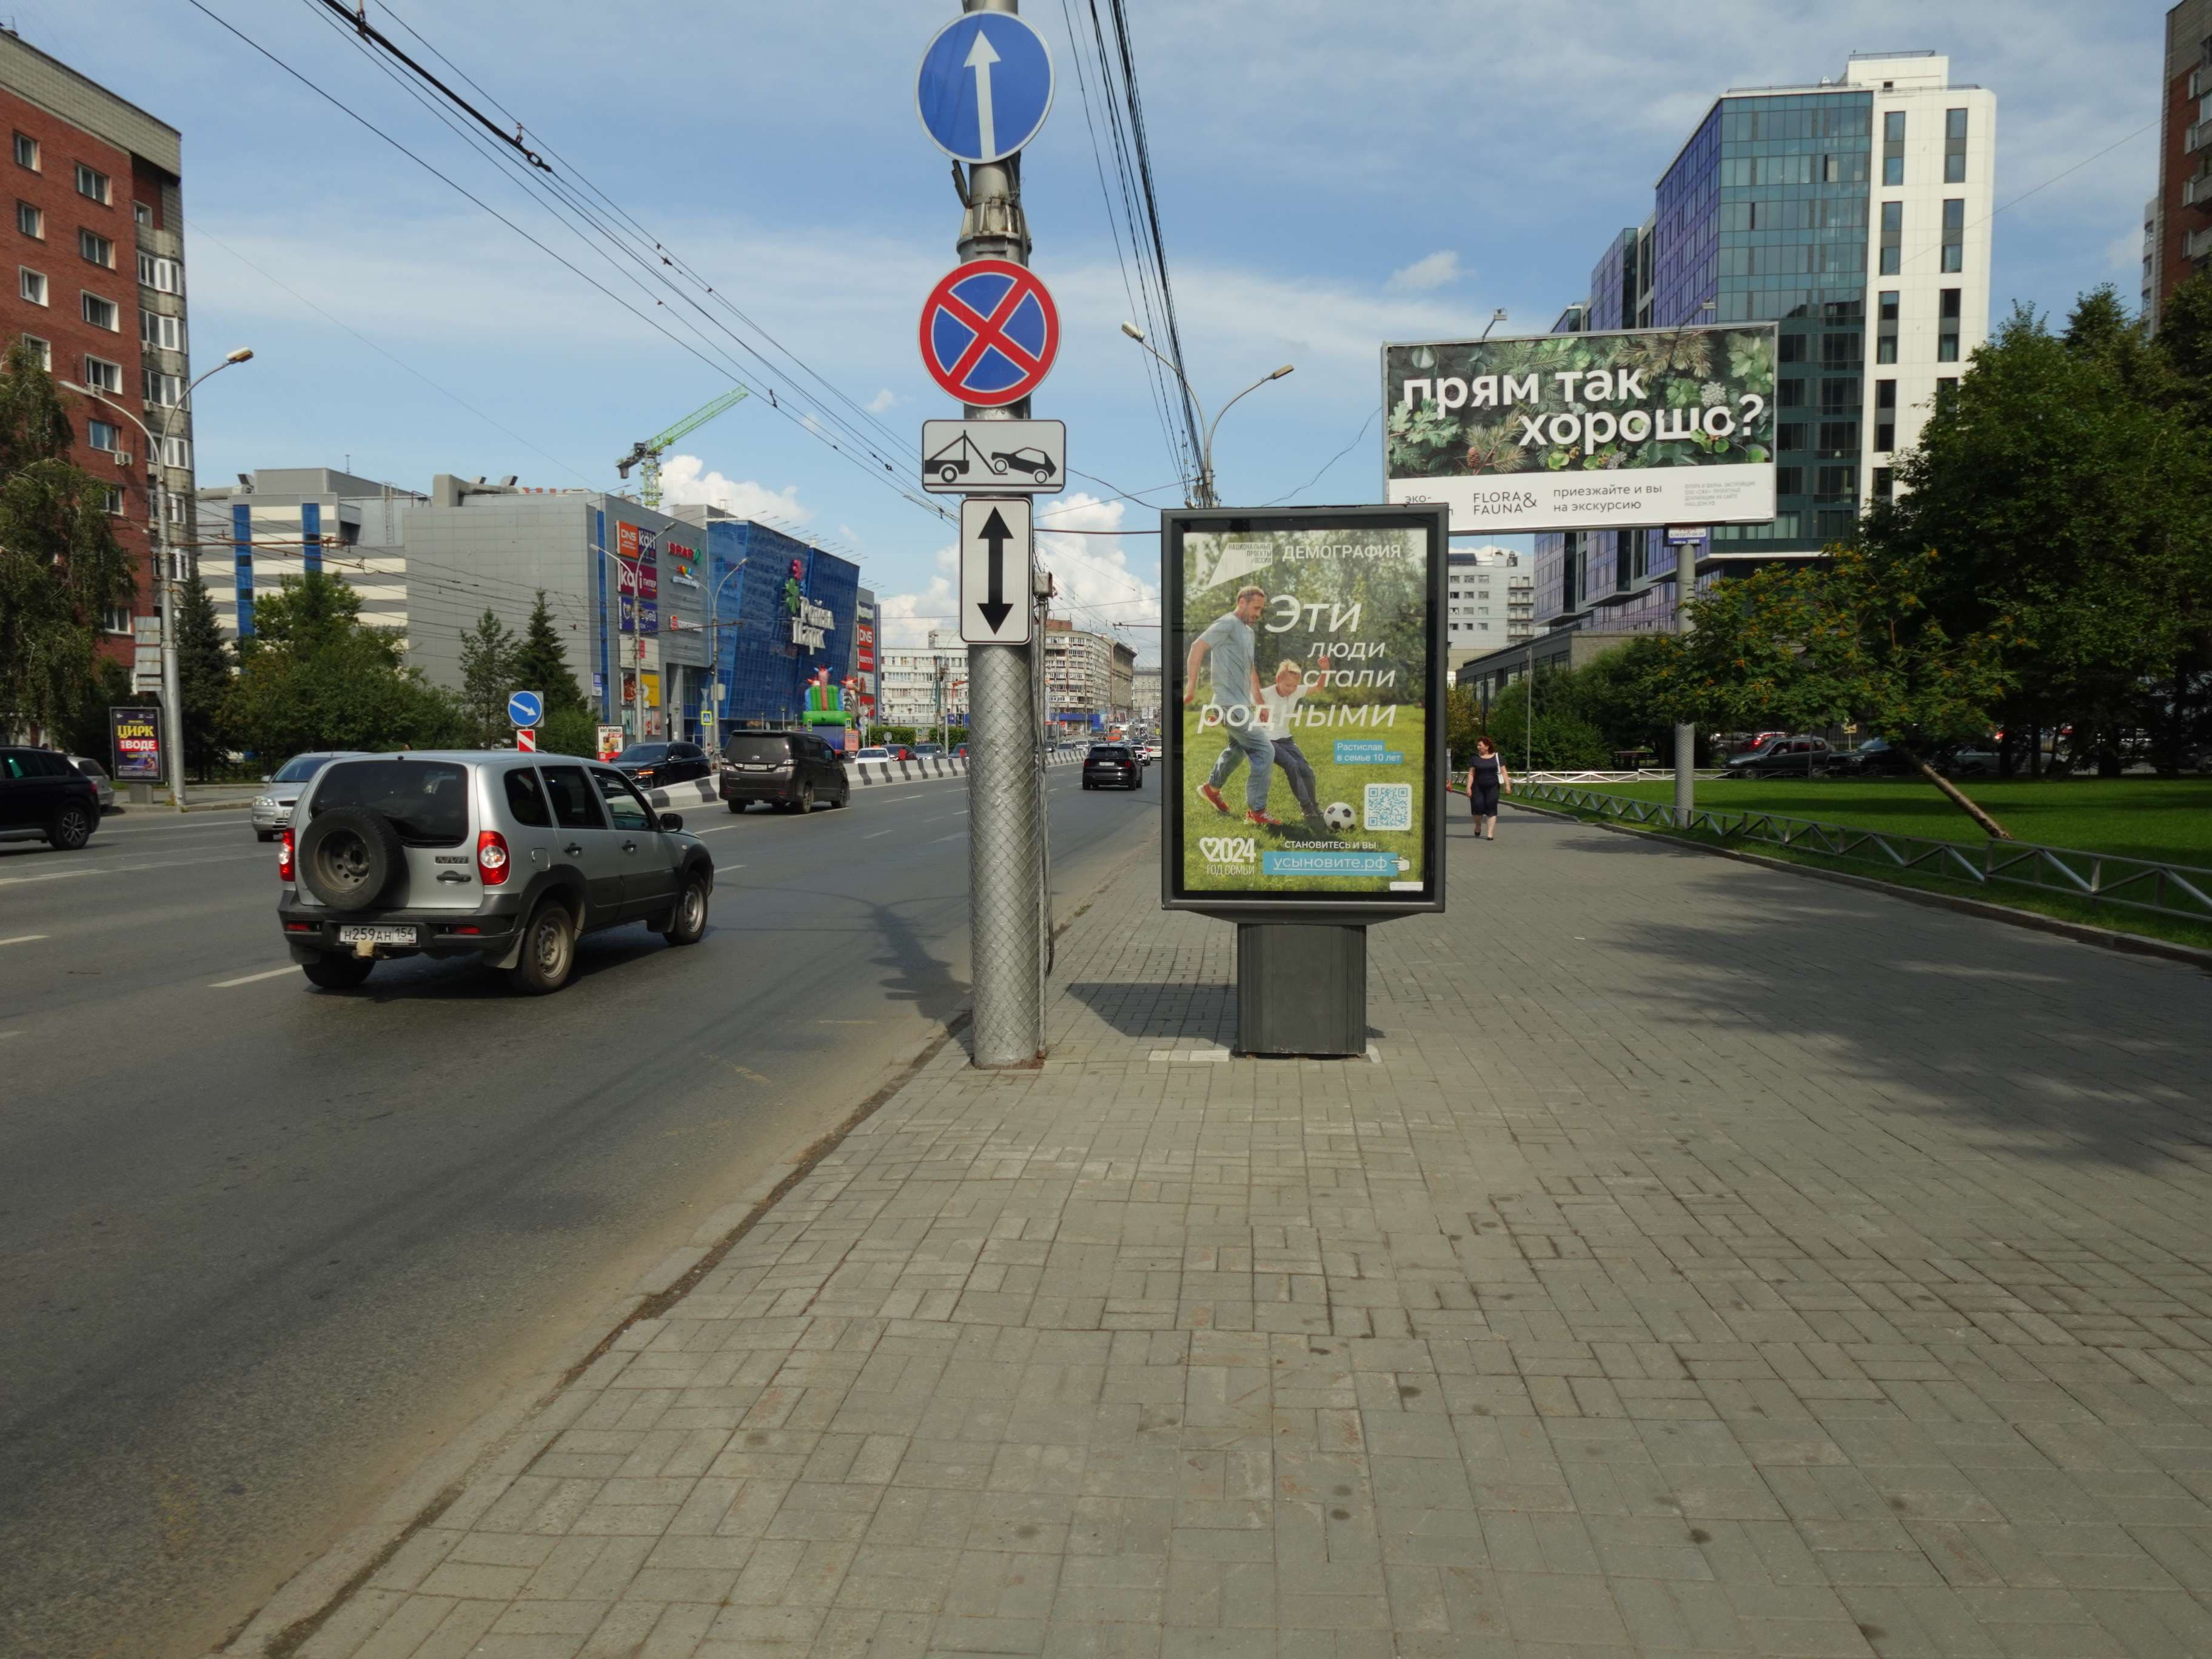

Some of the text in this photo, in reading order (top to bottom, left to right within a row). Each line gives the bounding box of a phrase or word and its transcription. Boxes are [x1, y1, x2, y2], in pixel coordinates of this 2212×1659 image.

[1403, 368, 1647, 418] прям так
[1519, 394, 1764, 455] хорошо?
[1473, 492, 1521, 503] FLORA
[1553, 484, 1631, 499] приезжайте
[1646, 486, 1662, 494] вы
[1473, 503, 1523, 515] FAUNA
[1572, 501, 1642, 514] экскурсию
[620, 529, 636, 541] DNS
[668, 541, 695, 560] SPAR
[1282, 545, 1401, 562] ДЕМОГРАФИЯ
[1264, 594, 1362, 633] Эти
[792, 617, 826, 655] Парк
[859, 629, 873, 644] DNS
[1307, 642, 1386, 660] люди
[1303, 669, 1396, 688] стали
[1197, 704, 1397, 734] родными
[117, 725, 154, 739] ЦИРК
[126, 740, 156, 751] ВОДЕ
[1337, 742, 1383, 751] Растислав
[1207, 837, 1256, 863] 2024
[1273, 856, 1387, 870] усыновите.рф
[344, 925, 414, 941] Н259АН 154
